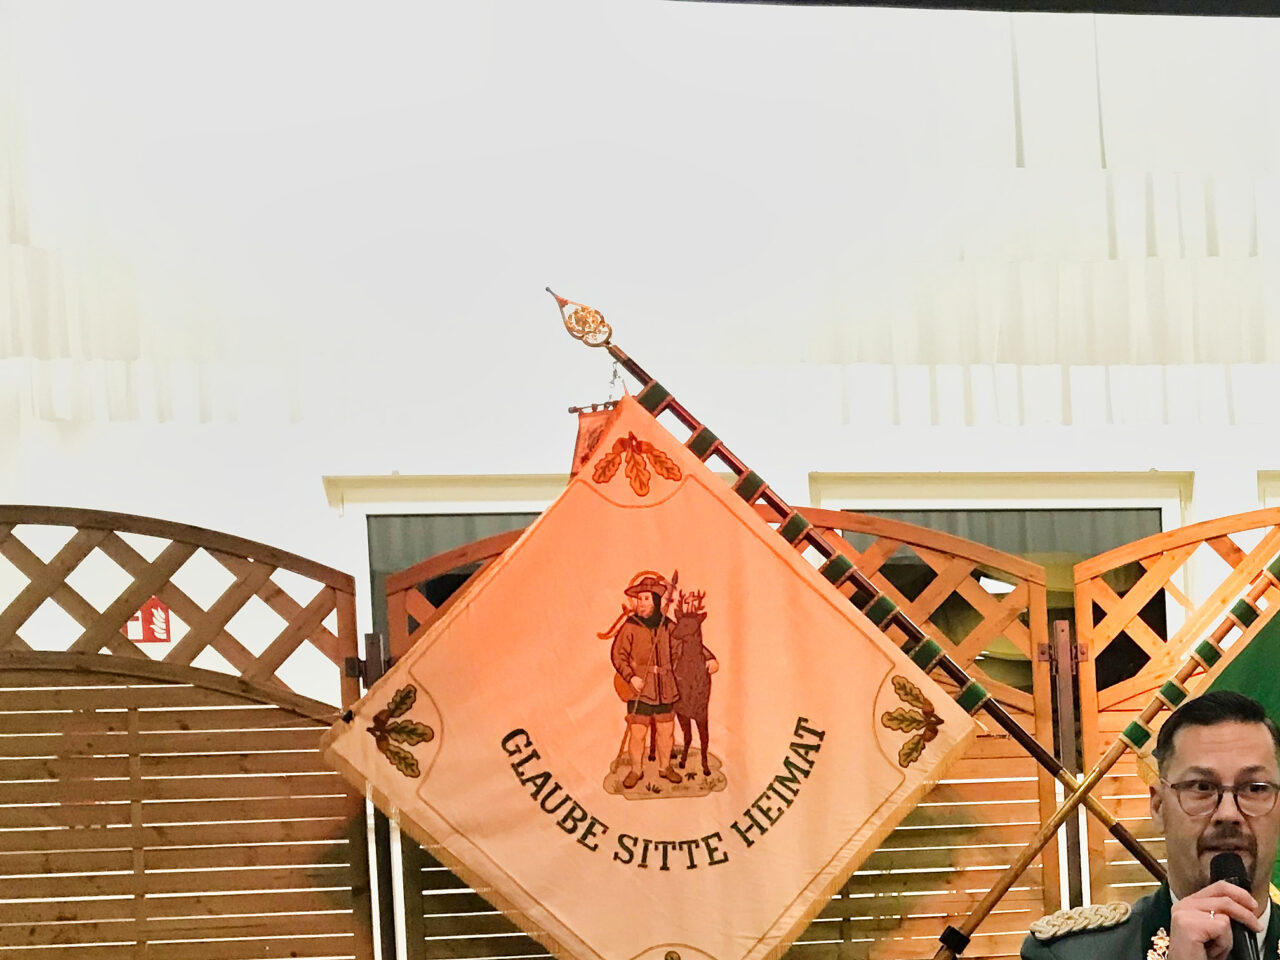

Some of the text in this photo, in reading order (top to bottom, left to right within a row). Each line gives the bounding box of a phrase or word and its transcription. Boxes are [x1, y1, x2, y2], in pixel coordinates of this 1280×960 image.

[501, 716, 826, 871] GLAUBE SITTE HEIMAT
